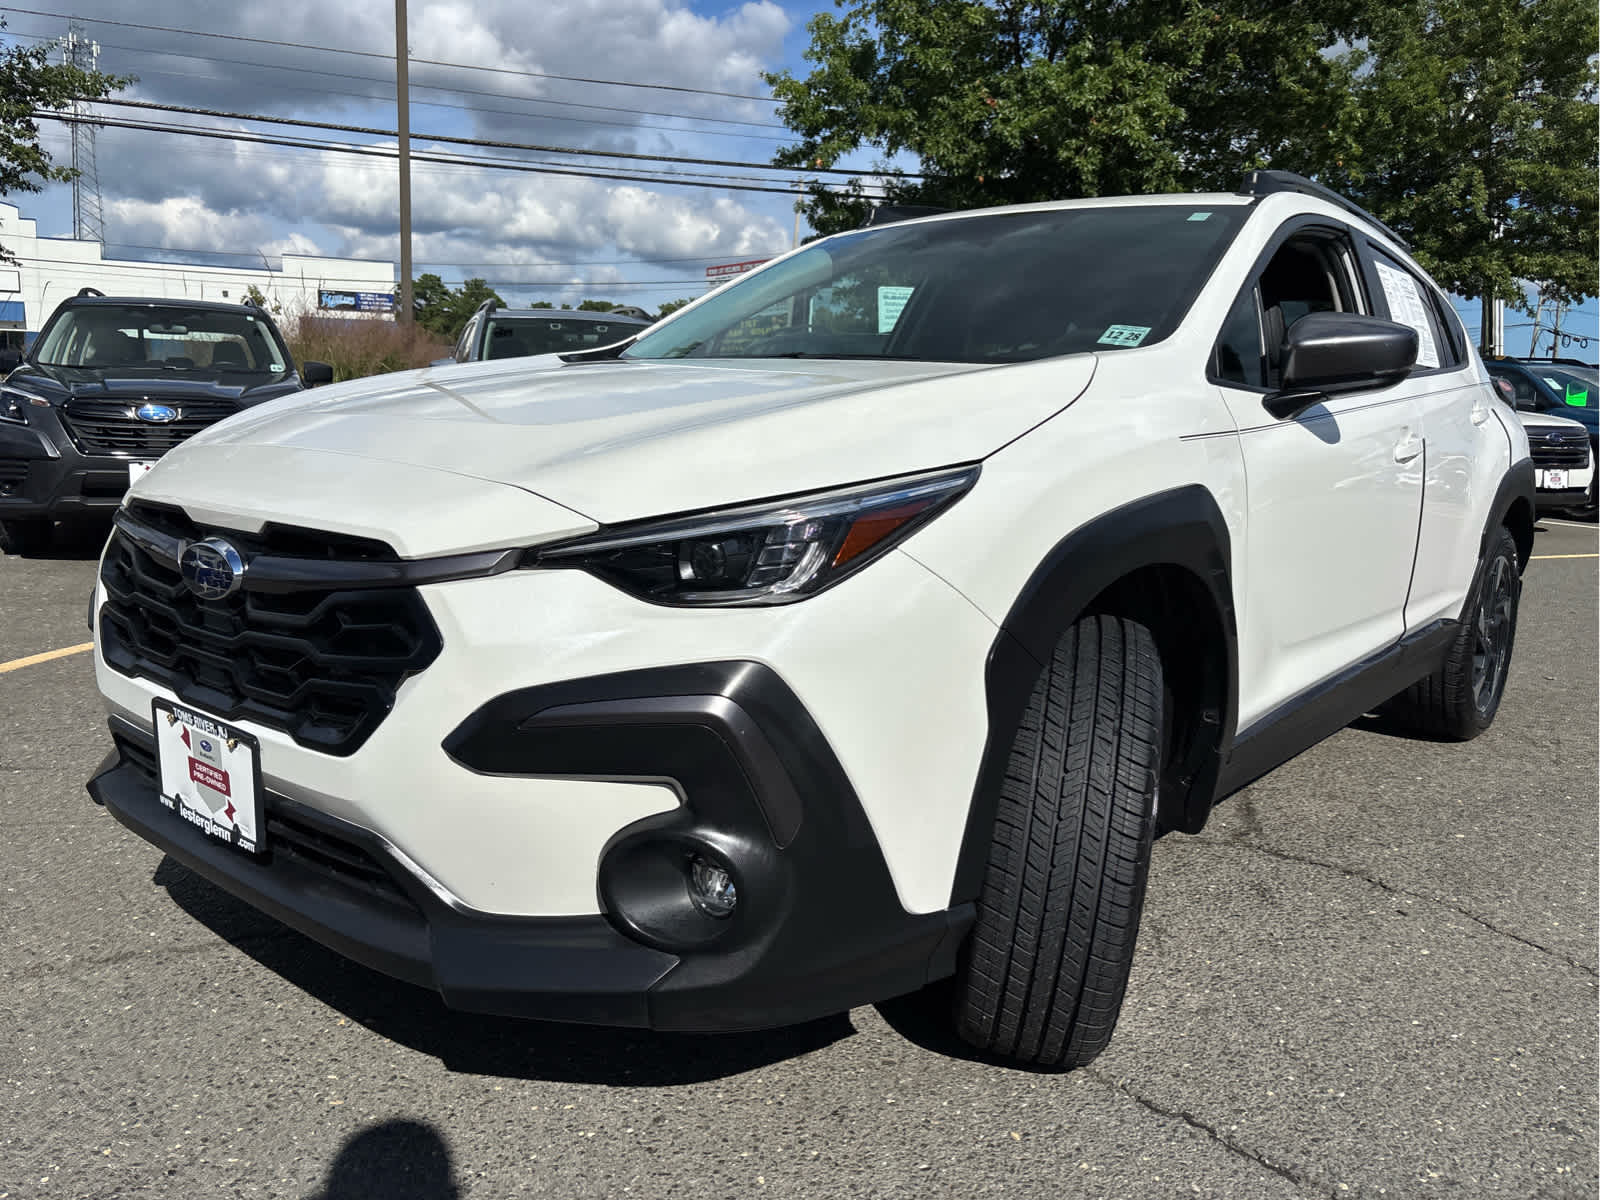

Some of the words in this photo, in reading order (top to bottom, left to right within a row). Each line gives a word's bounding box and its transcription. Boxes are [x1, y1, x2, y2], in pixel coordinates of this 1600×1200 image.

[1106, 330, 1124, 339] 12
[173, 708, 194, 725] TOMS
[218, 725, 228, 739] NJ
[193, 770, 226, 791] PRE-OWNED
[194, 762, 223, 781] CERTIFIED
[180, 803, 231, 842] lesterglenn
